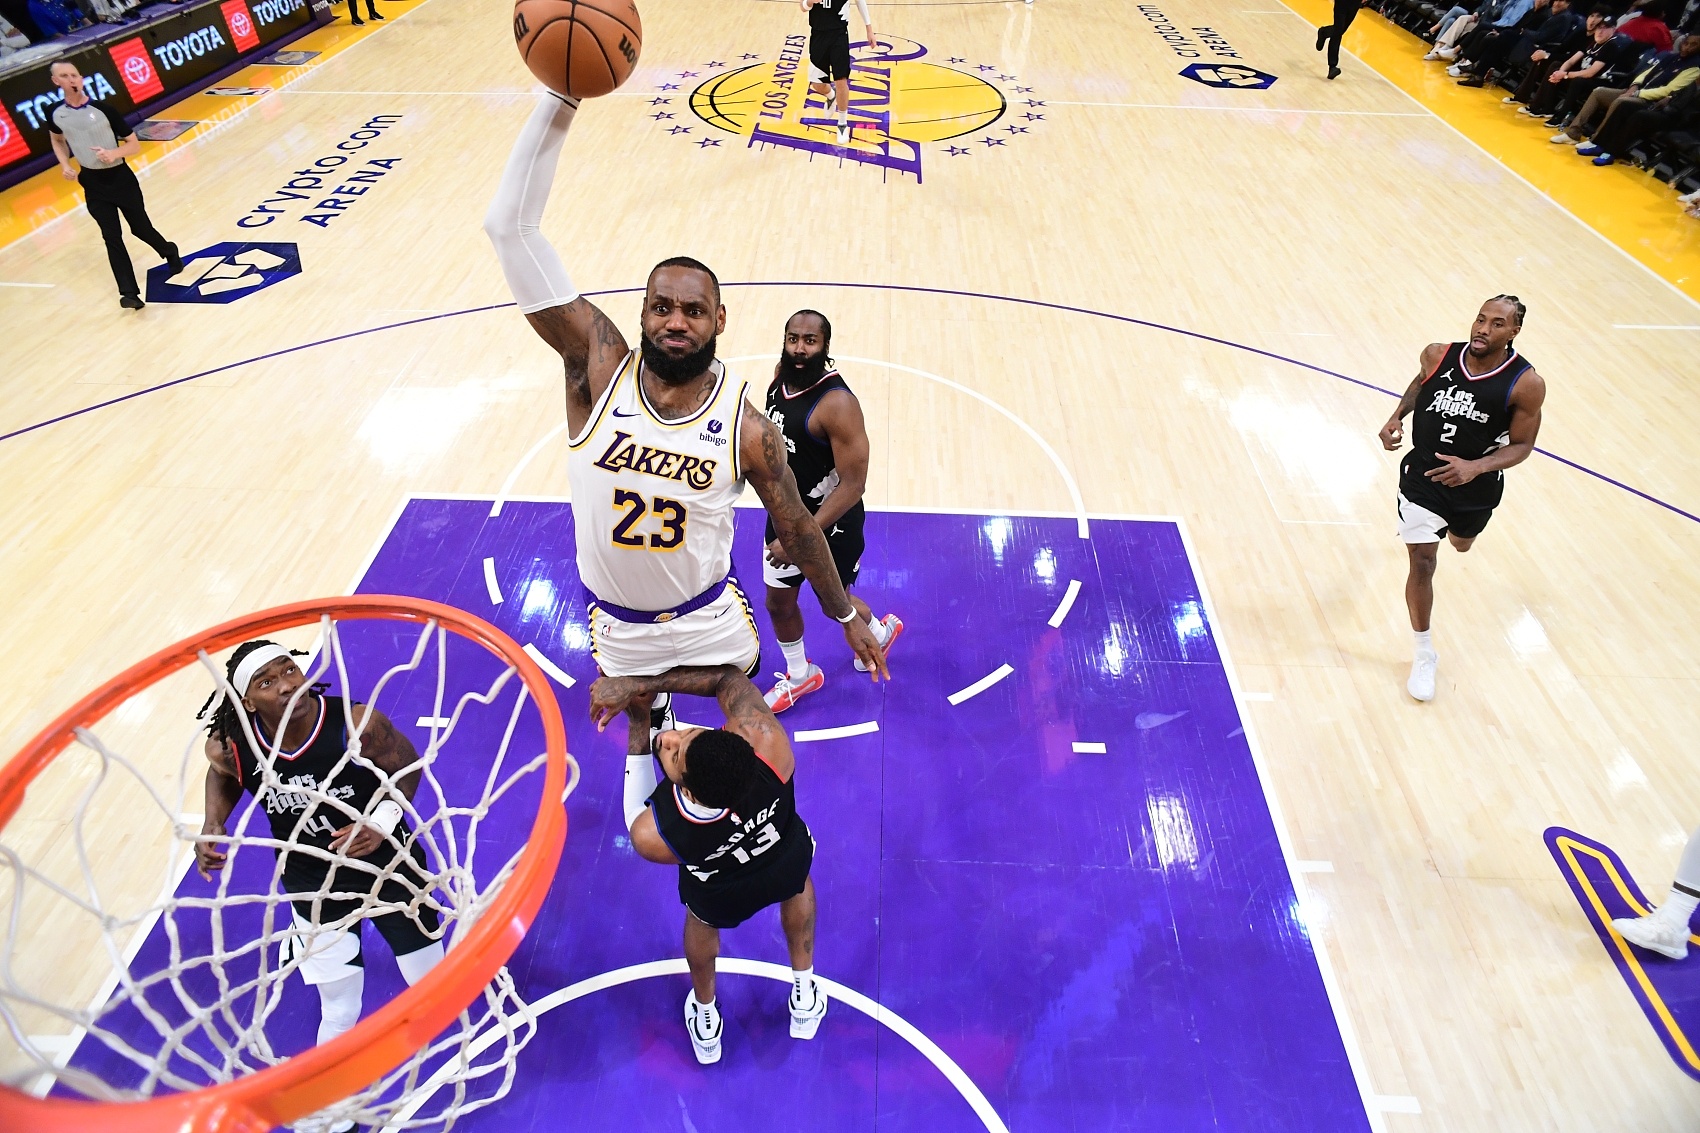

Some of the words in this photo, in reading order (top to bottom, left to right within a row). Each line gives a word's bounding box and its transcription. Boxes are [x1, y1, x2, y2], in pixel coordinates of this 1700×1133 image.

[158, 25, 226, 71] TOYOTA
[1137, 5, 1201, 58] crypto.com
[1191, 27, 1243, 59] ARENA
[771, 34, 807, 90] ANGELES
[15, 72, 117, 129] TOYTA
[759, 91, 789, 119] LOS
[237, 115, 403, 228] crypto.com
[298, 158, 402, 228] ARENA
[1426, 390, 1490, 423] Angeles
[1444, 385, 1474, 405] Los
[699, 432, 727, 447] bibigo
[1440, 422, 1457, 444] 2
[592, 429, 718, 492] LAKERS
[611, 487, 688, 553] 23
[266, 784, 355, 815] Anges
[731, 822, 781, 864] 13
